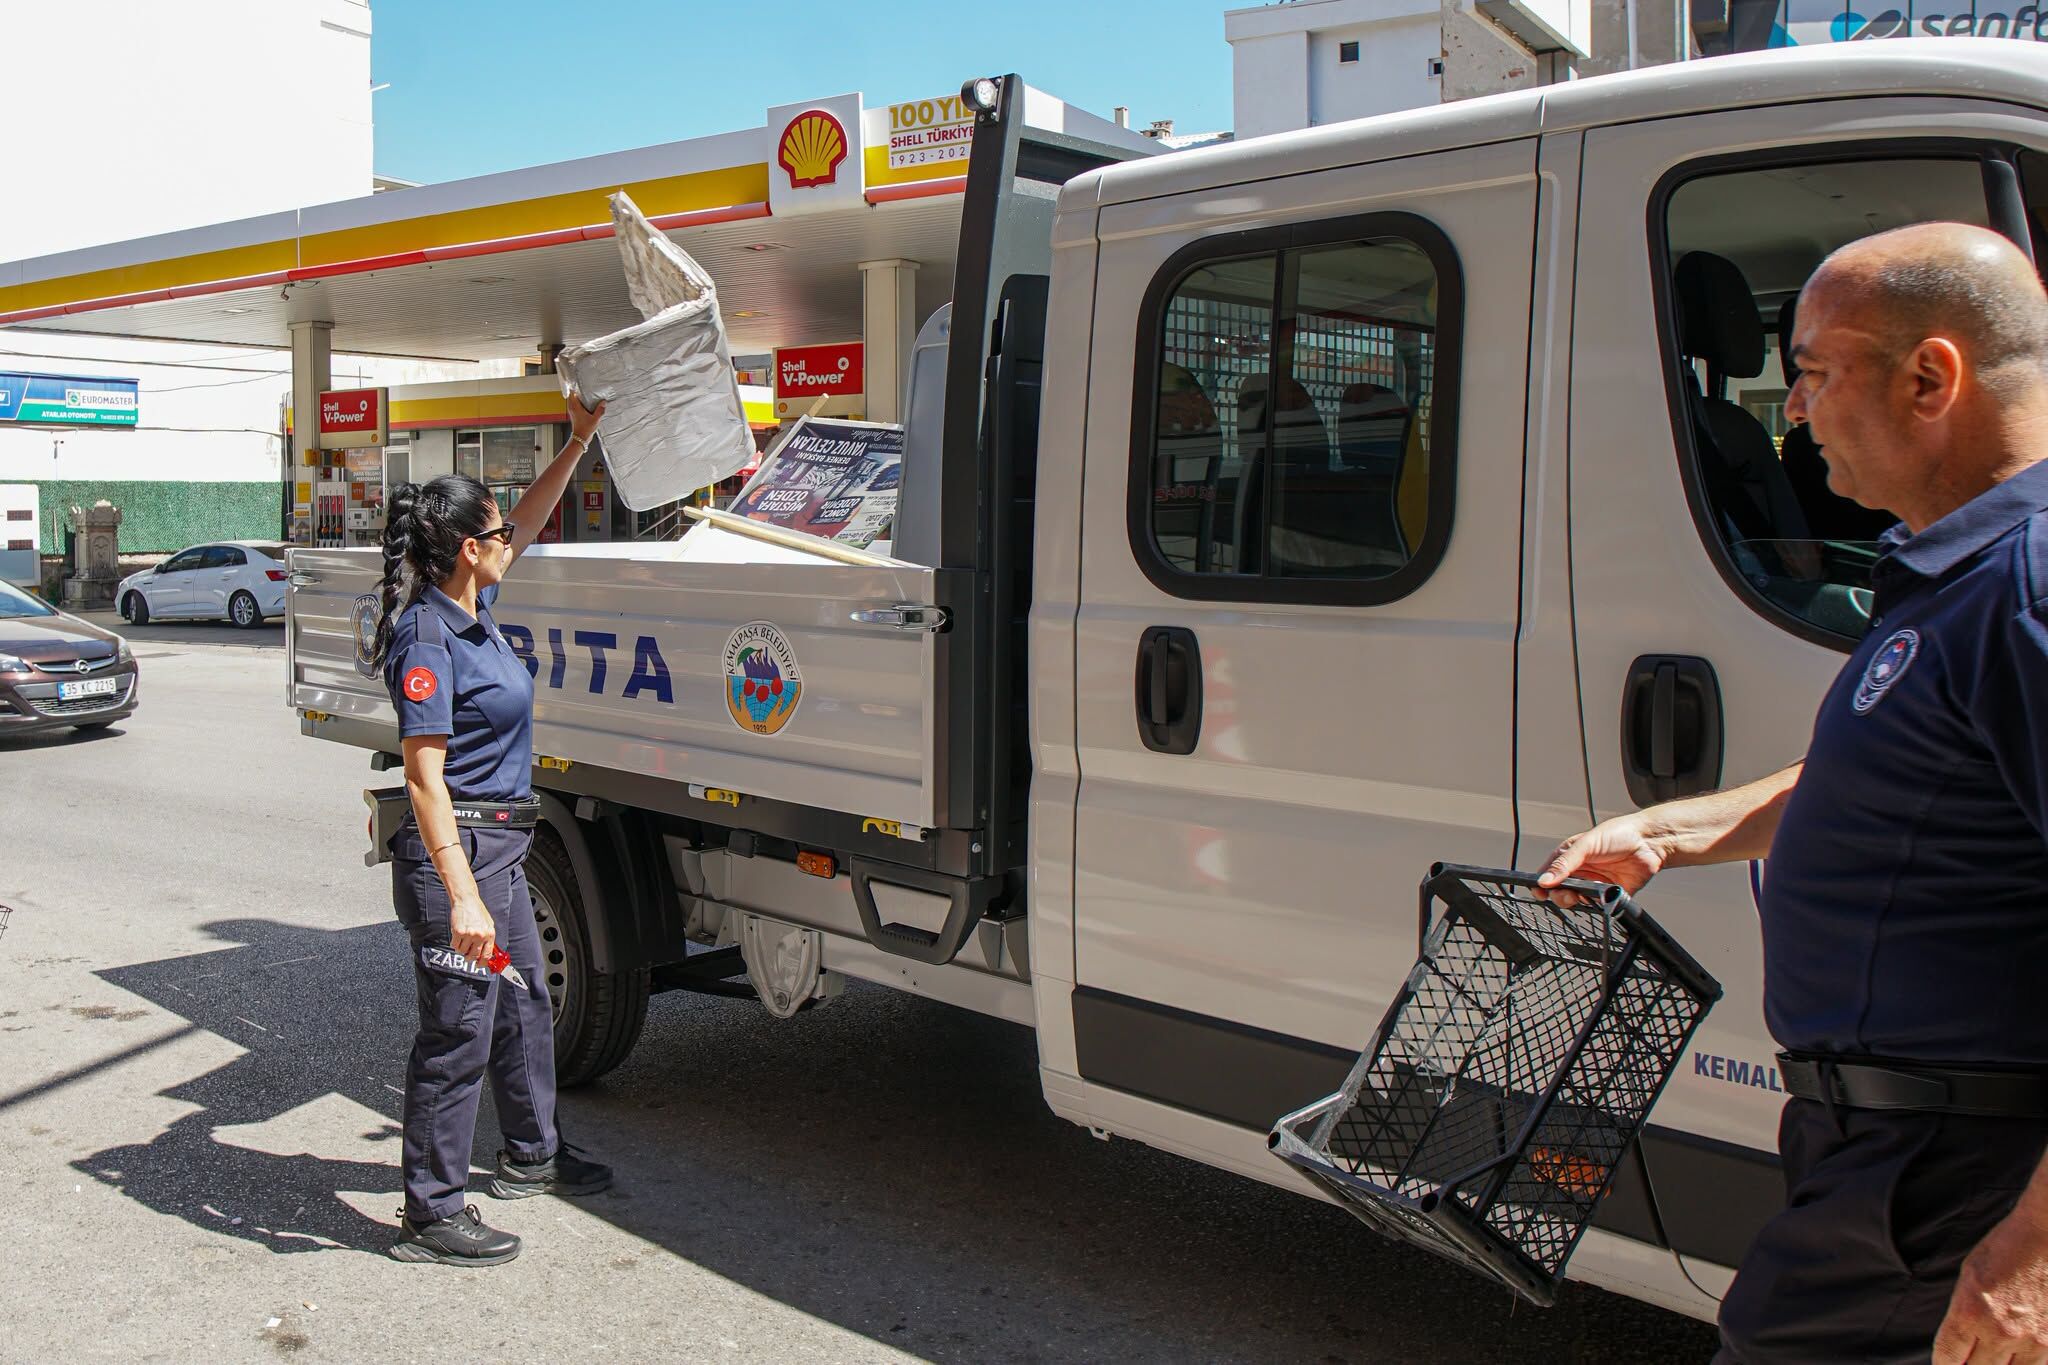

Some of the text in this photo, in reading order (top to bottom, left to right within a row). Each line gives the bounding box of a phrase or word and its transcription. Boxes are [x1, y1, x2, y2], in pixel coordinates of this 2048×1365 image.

[890, 101, 934, 128] 100
[890, 125, 974, 149] SHELL TÜRKİYE
[890, 146, 966, 167] 1923-202
[782, 359, 806, 372] Shell
[782, 372, 845, 387] V-Power
[82, 395, 133, 406] EUROMASTER
[323, 402, 339, 412] Shell
[324, 412, 365, 424] V-Power
[790, 435, 868, 457] YAVUZ CEYLAN
[757, 501, 807, 512] MUSTAFA
[728, 626, 759, 675] KEMALPAŞA
[499, 623, 674, 704] BITA
[66, 679, 115, 695] 35 KC 2215
[453, 809, 482, 819] BITA
[1694, 1051, 1785, 1093] KEMAL
